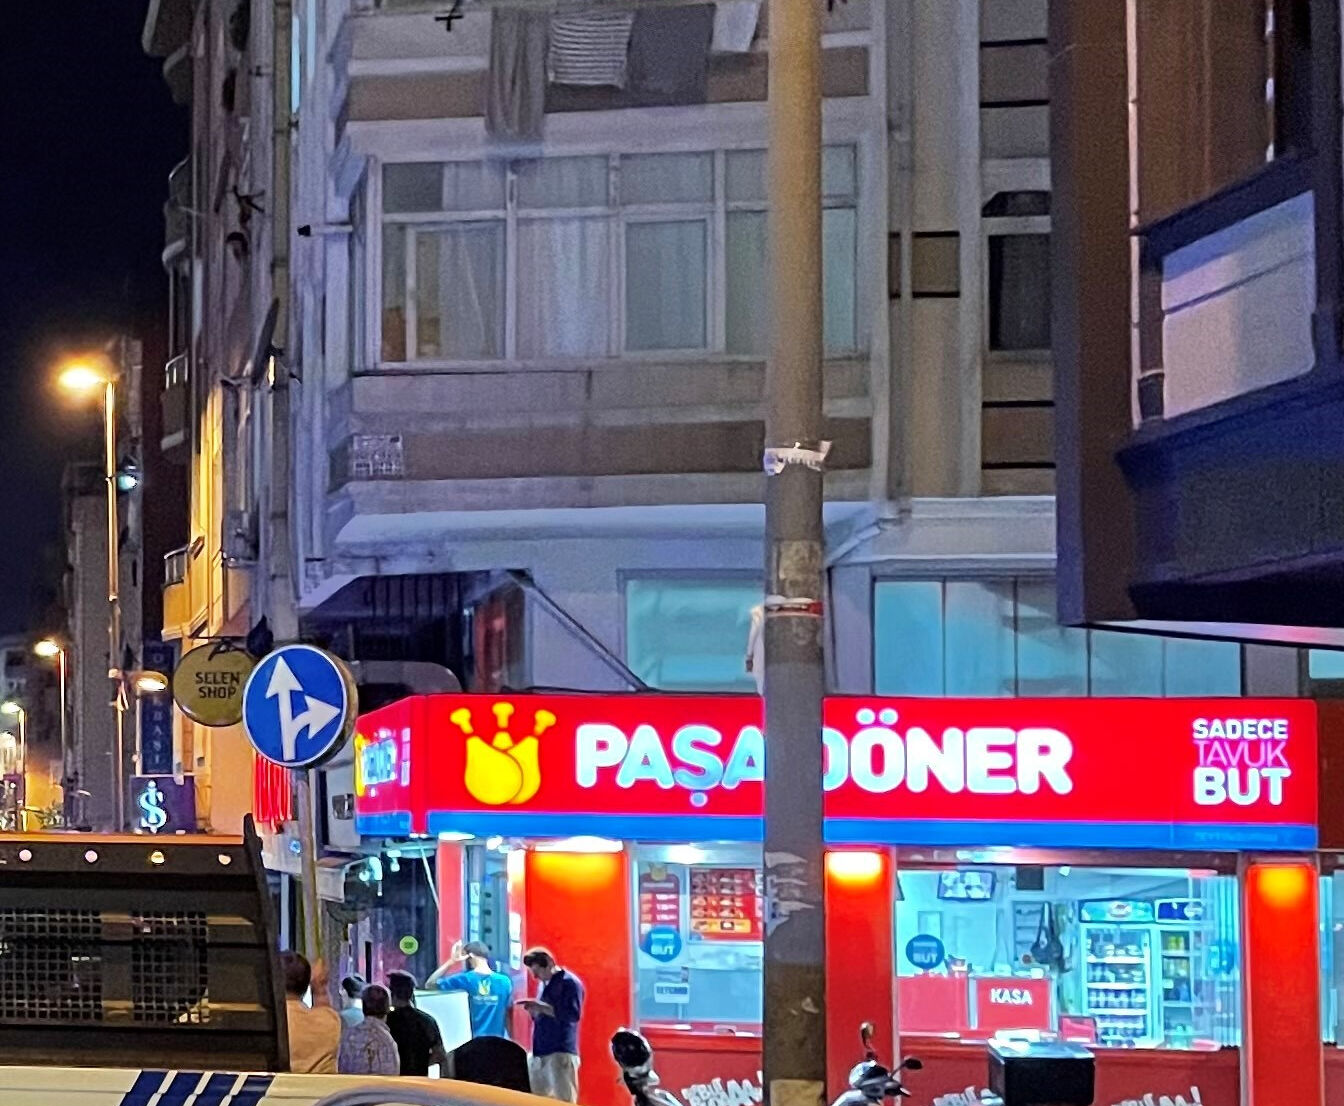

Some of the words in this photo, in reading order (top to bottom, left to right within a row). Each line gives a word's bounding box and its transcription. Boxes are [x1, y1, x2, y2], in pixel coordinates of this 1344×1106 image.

[195, 671, 241, 686] SELEN
[198, 686, 237, 700] SHOP
[1192, 717, 1289, 740] SADECE
[575, 722, 766, 808] PAŞA
[1193, 740, 1289, 767] TAVUK
[1193, 766, 1292, 806] BUT
[990, 988, 1033, 1006] KASA
